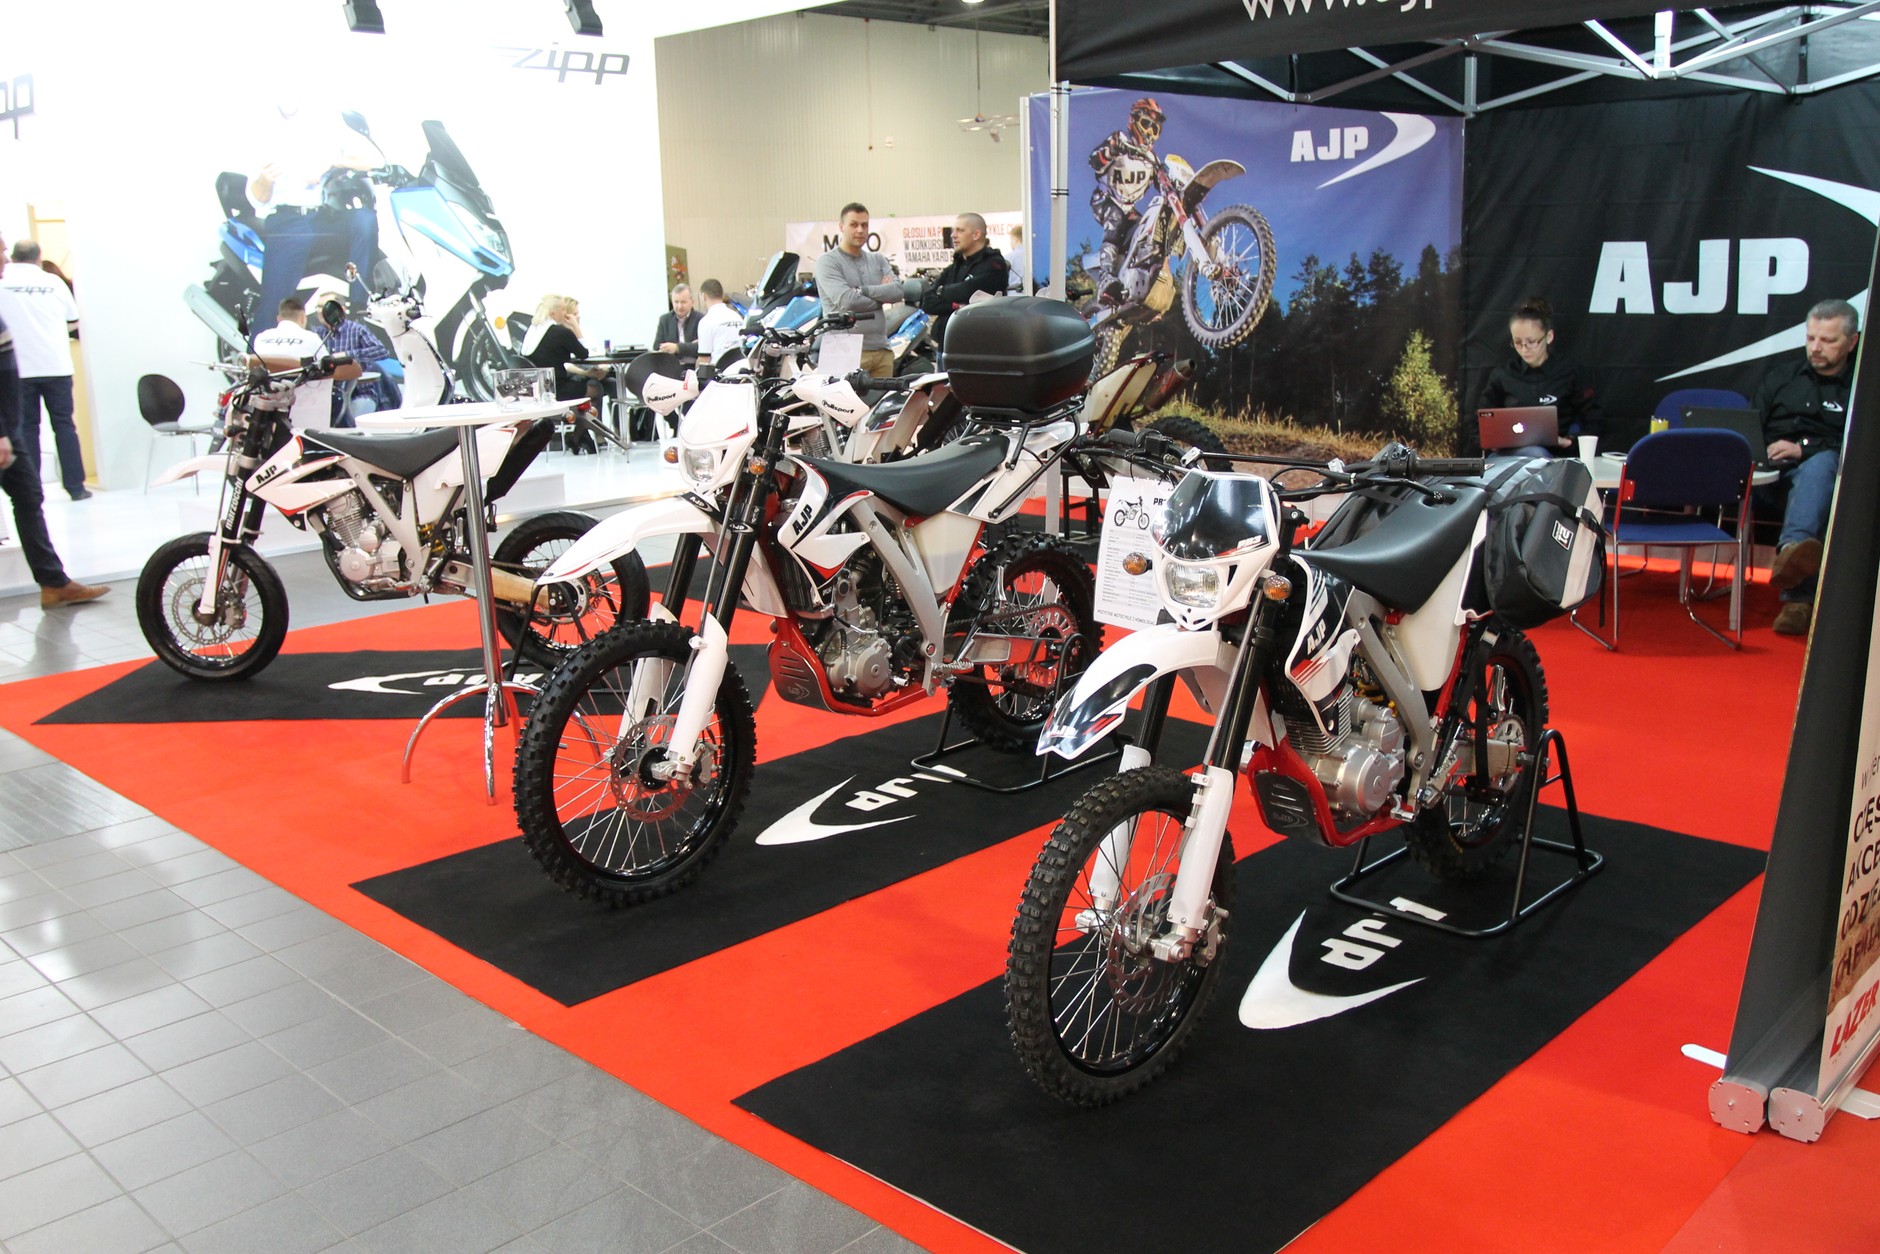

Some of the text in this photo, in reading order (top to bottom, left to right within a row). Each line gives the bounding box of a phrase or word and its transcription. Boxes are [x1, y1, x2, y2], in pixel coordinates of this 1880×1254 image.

[503, 41, 630, 85] zipp
[1290, 126, 1369, 162] AJP
[1112, 169, 1146, 184] AJP
[823, 232, 882, 253] MO
[927, 226, 937, 238] NA
[904, 251, 931, 262] YAMAHA
[931, 251, 949, 262] YARD
[1588, 237, 1810, 315] AJP
[255, 465, 277, 484] AJP
[791, 504, 813, 536] AJP
[1307, 618, 1327, 655] AJP
[1829, 979, 1880, 1058] LAZER
